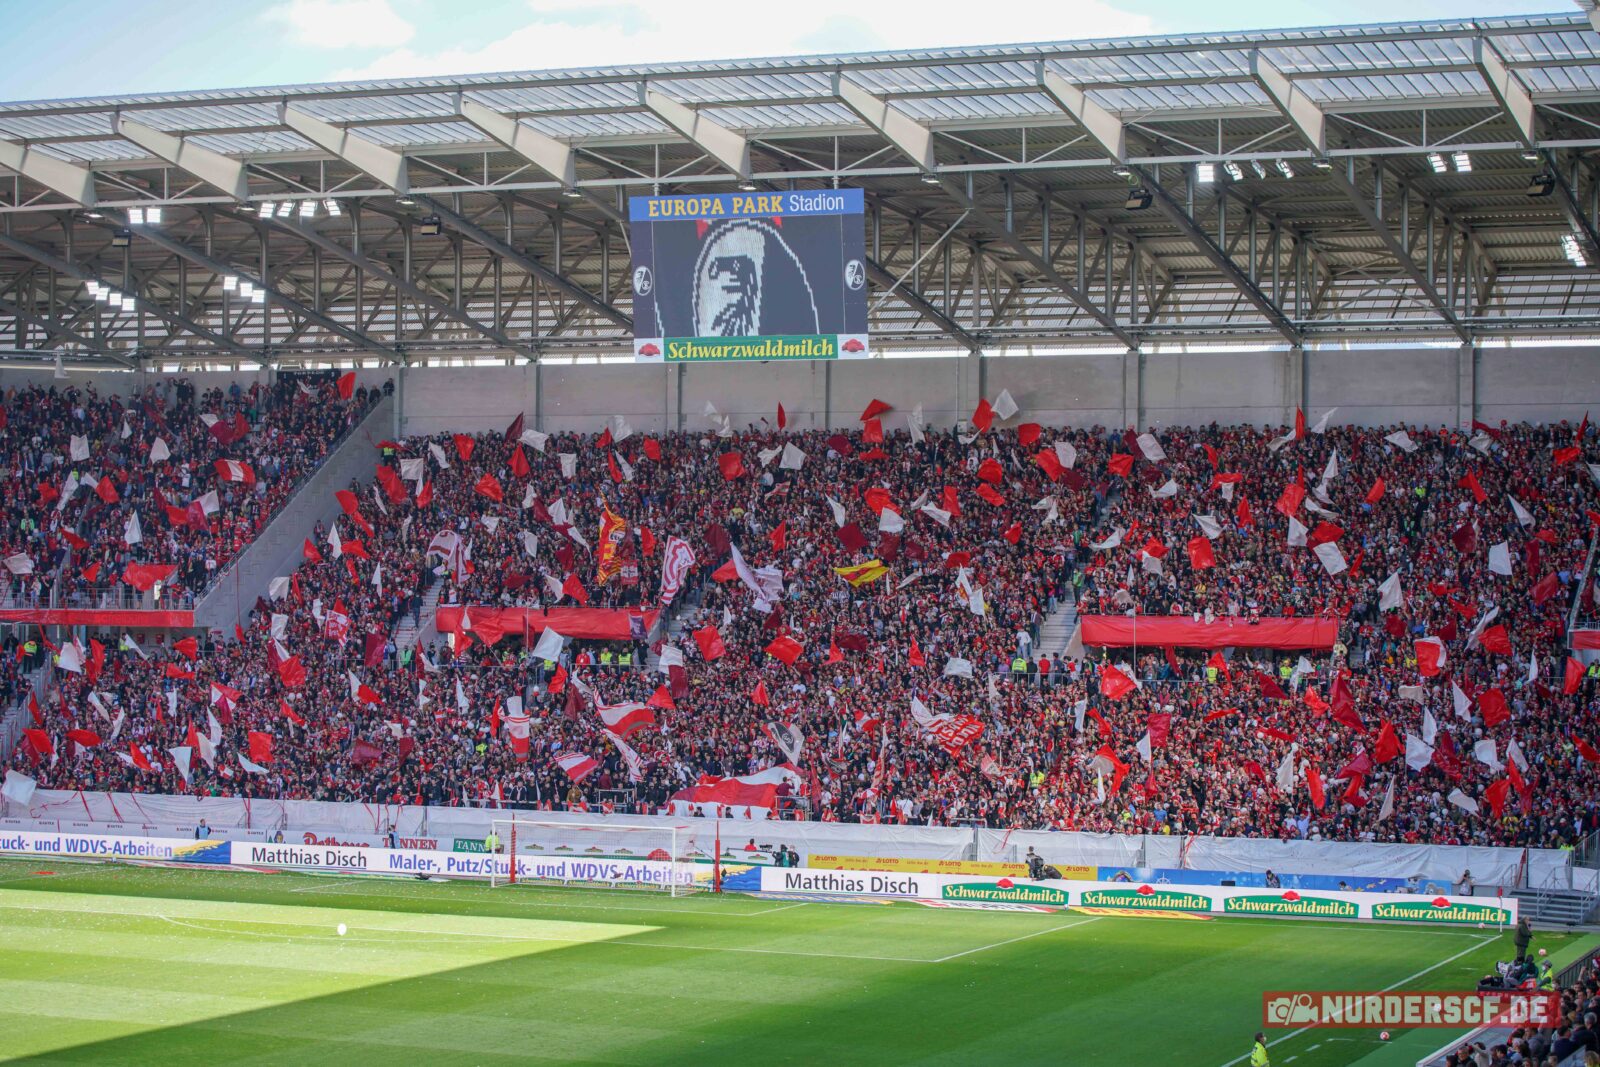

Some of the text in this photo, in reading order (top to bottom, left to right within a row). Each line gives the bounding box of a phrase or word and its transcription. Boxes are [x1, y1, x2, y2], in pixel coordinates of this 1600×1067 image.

[648, 194, 844, 217] EUROPA PARK Stadion
[668, 339, 834, 359] Schwarzwaldmilch
[34, 836, 61, 852] und
[65, 838, 173, 858] WDVS-Arbeiten
[382, 837, 438, 850] TNNEN
[251, 847, 320, 865] Matthias
[325, 850, 367, 867] Disch
[447, 857, 531, 875] Putz/Stuk-
[536, 861, 566, 877] und
[571, 863, 693, 884] WDVSArbeiten
[785, 873, 919, 894] Matthias Disch
[945, 885, 1065, 903] Schwarzwaldmilch
[1084, 891, 1208, 909] Schwarzwaldmilch
[1227, 897, 1356, 916] Schwarzwaldmilch
[1375, 903, 1508, 923] Schwarzwaldmilch
